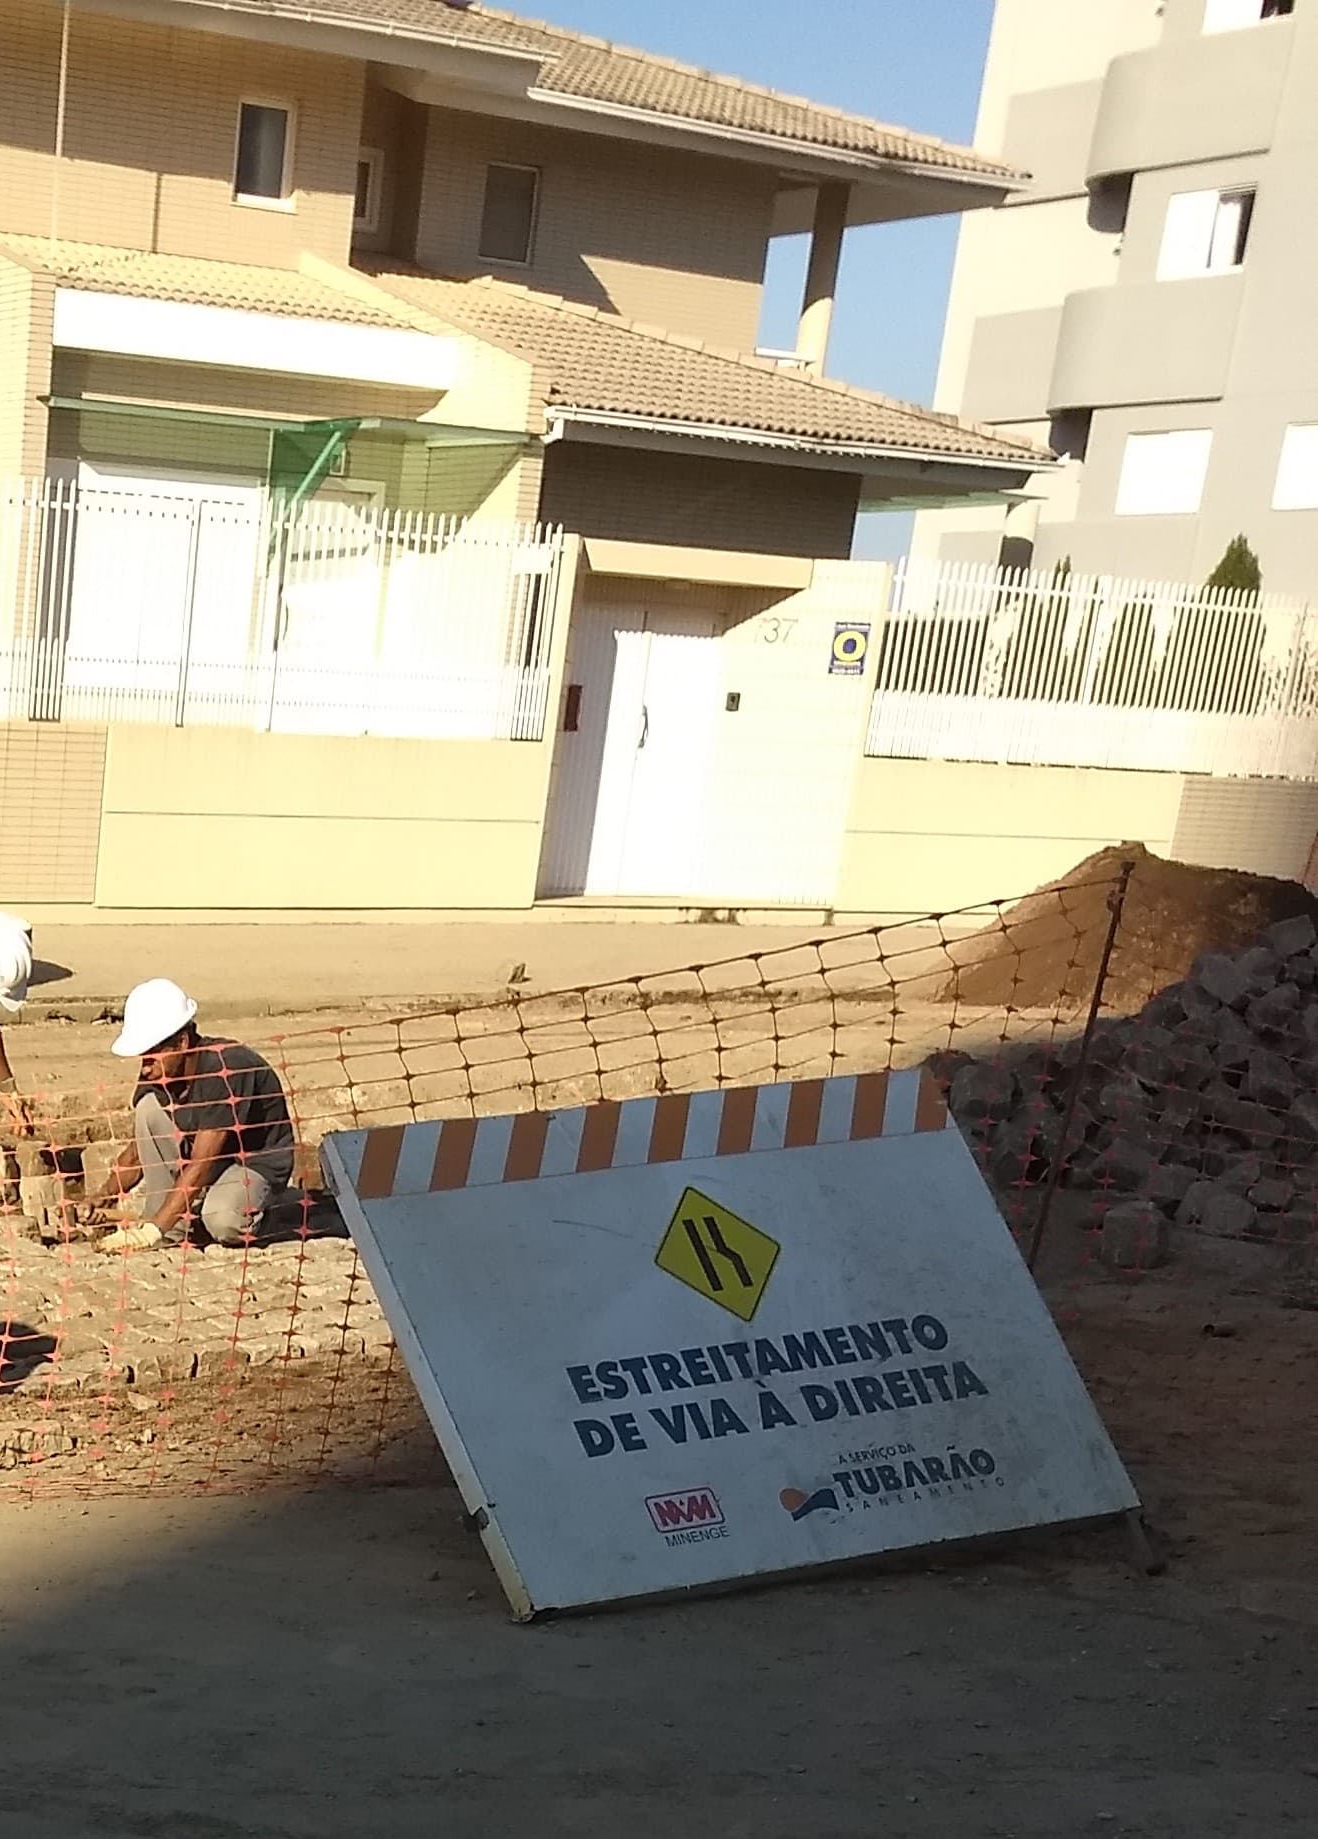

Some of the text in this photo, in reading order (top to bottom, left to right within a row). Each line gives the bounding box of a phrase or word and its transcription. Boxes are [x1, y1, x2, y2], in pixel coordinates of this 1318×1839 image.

[566, 1314, 948, 1403] ESTREITAMENTO
[574, 1361, 988, 1458] DE VIA À DIREITA
[832, 1445, 995, 1498] TUBARÃO
[849, 1446, 896, 1463] SERVIÇO
[898, 1443, 916, 1456] DA
[845, 1477, 1005, 1512] SANEAMENTO
[665, 1526, 730, 1547] MINENGE
